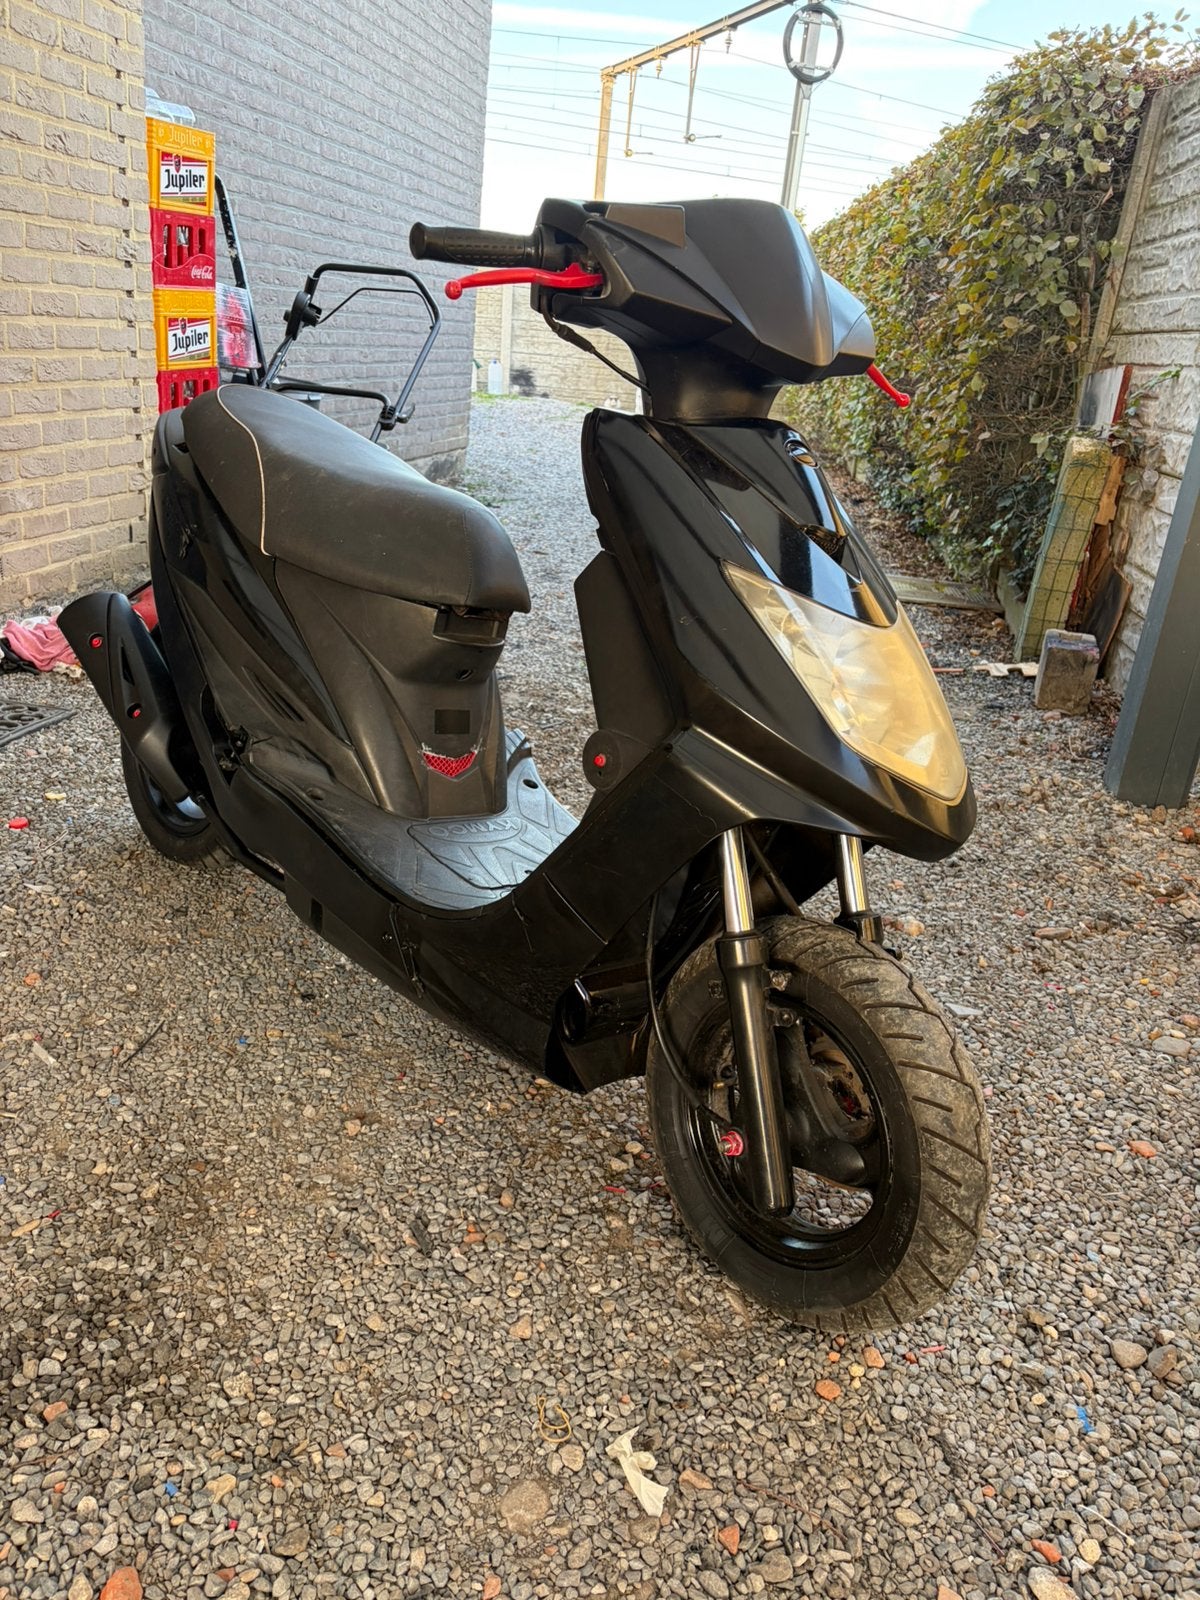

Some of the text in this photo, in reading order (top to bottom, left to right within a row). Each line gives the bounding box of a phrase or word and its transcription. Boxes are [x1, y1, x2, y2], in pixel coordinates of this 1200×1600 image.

[164, 169, 205, 192] Jupiler
[172, 329, 208, 352] Jupiler
[428, 818, 519, 837] KYMCO
